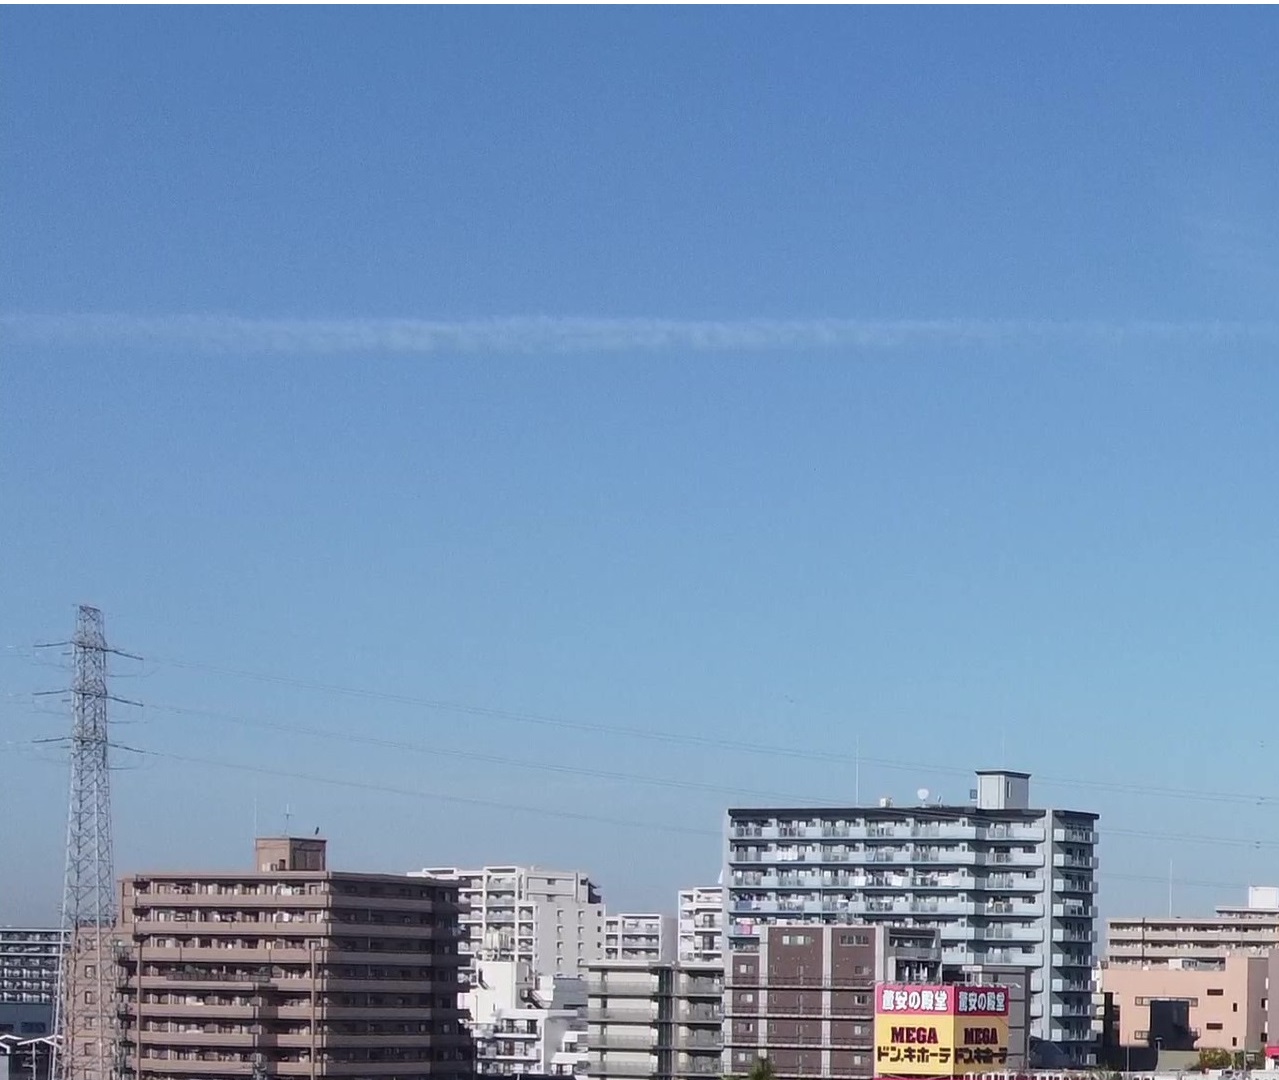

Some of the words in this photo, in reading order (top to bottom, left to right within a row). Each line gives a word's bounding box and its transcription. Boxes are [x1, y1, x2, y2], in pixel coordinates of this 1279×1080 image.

[882, 989, 948, 1011] 驚安の殿堂
[890, 1026, 939, 1044] MEGA
[964, 1027, 999, 1045] MEGA
